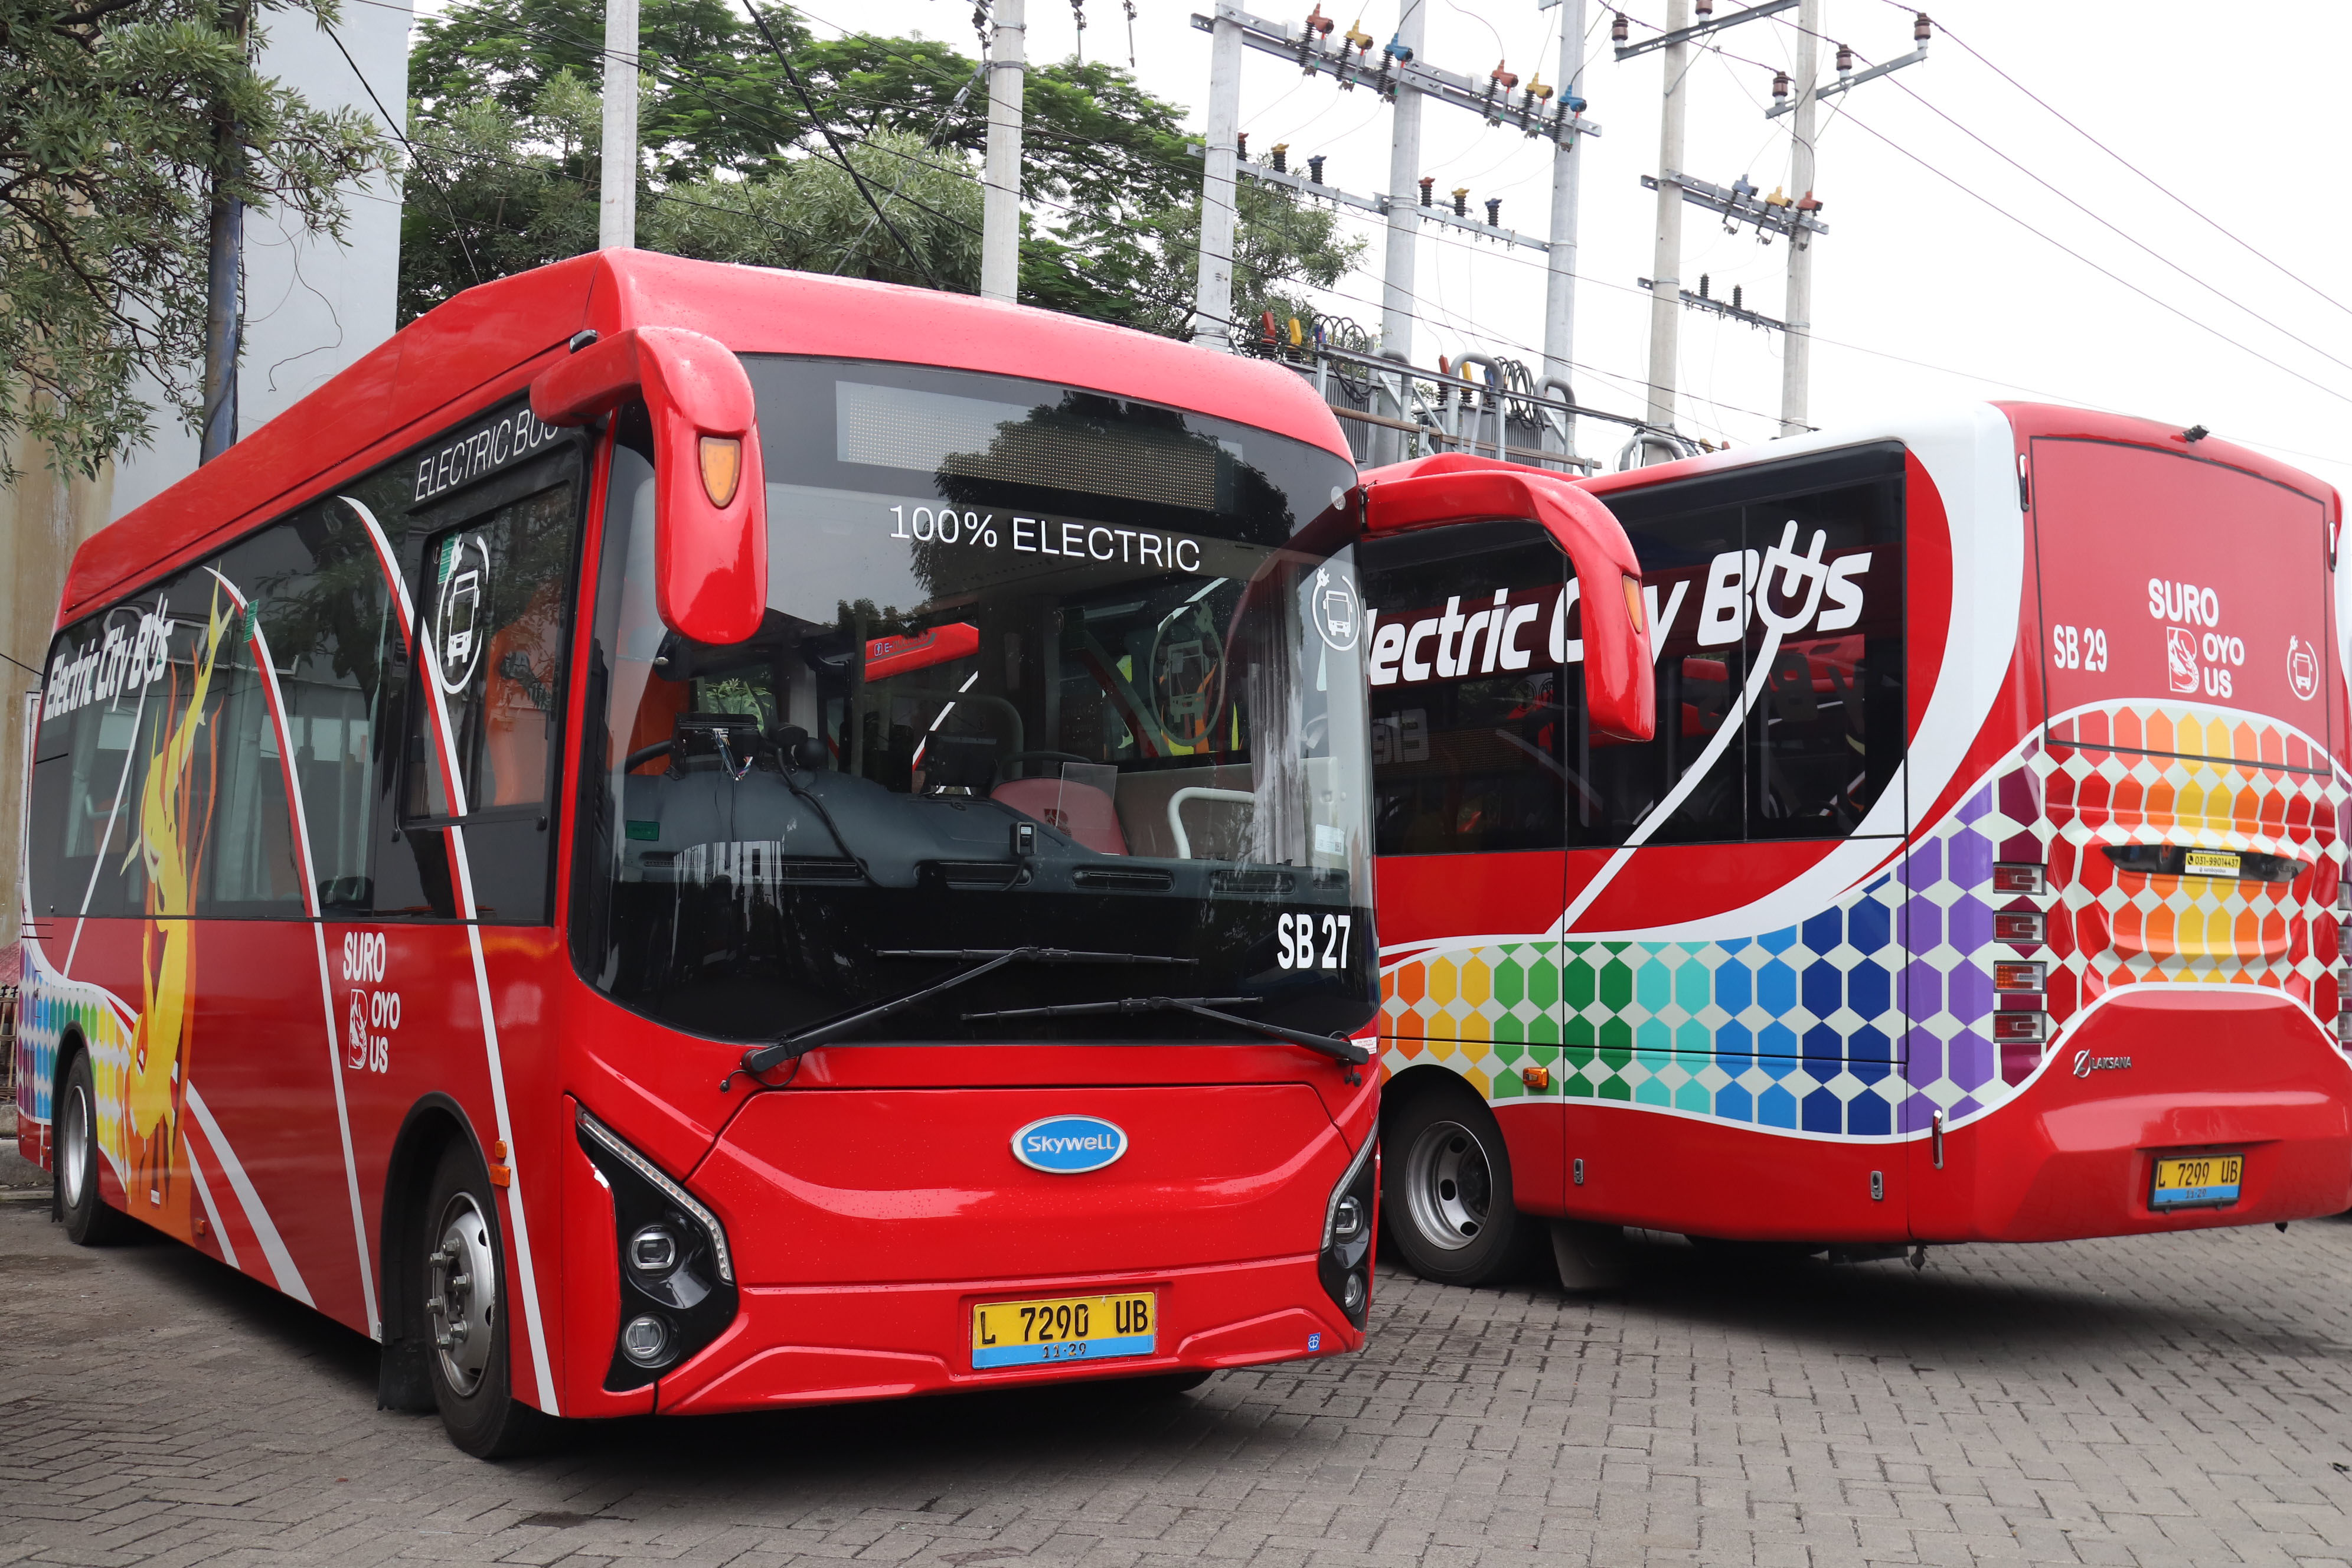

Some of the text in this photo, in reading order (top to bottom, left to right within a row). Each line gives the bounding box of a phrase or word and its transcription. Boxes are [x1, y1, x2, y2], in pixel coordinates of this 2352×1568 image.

[415, 419, 511, 501] ELECTRIC
[888, 505, 1200, 572] 100% ELECTRIC
[1549, 577, 1690, 667] Cy
[2148, 578, 2219, 627] SURO
[2053, 624, 2107, 672] SB 29
[2202, 633, 2245, 666] OYO
[44, 638, 100, 721] Electric
[95, 625, 134, 711] City
[2204, 667, 2232, 698] US
[2195, 855, 2239, 867] 031-99014437
[343, 932, 386, 982] SURO
[1277, 913, 1351, 969] SB 27
[371, 991, 400, 1030] OYO
[370, 1035, 388, 1073] US
[2092, 1057, 2132, 1069] LAKSANA
[1027, 1134, 1115, 1154] Skywell
[2158, 1160, 2237, 1187] L 7299 UB
[981, 1299, 1148, 1345] L 7290 UB
